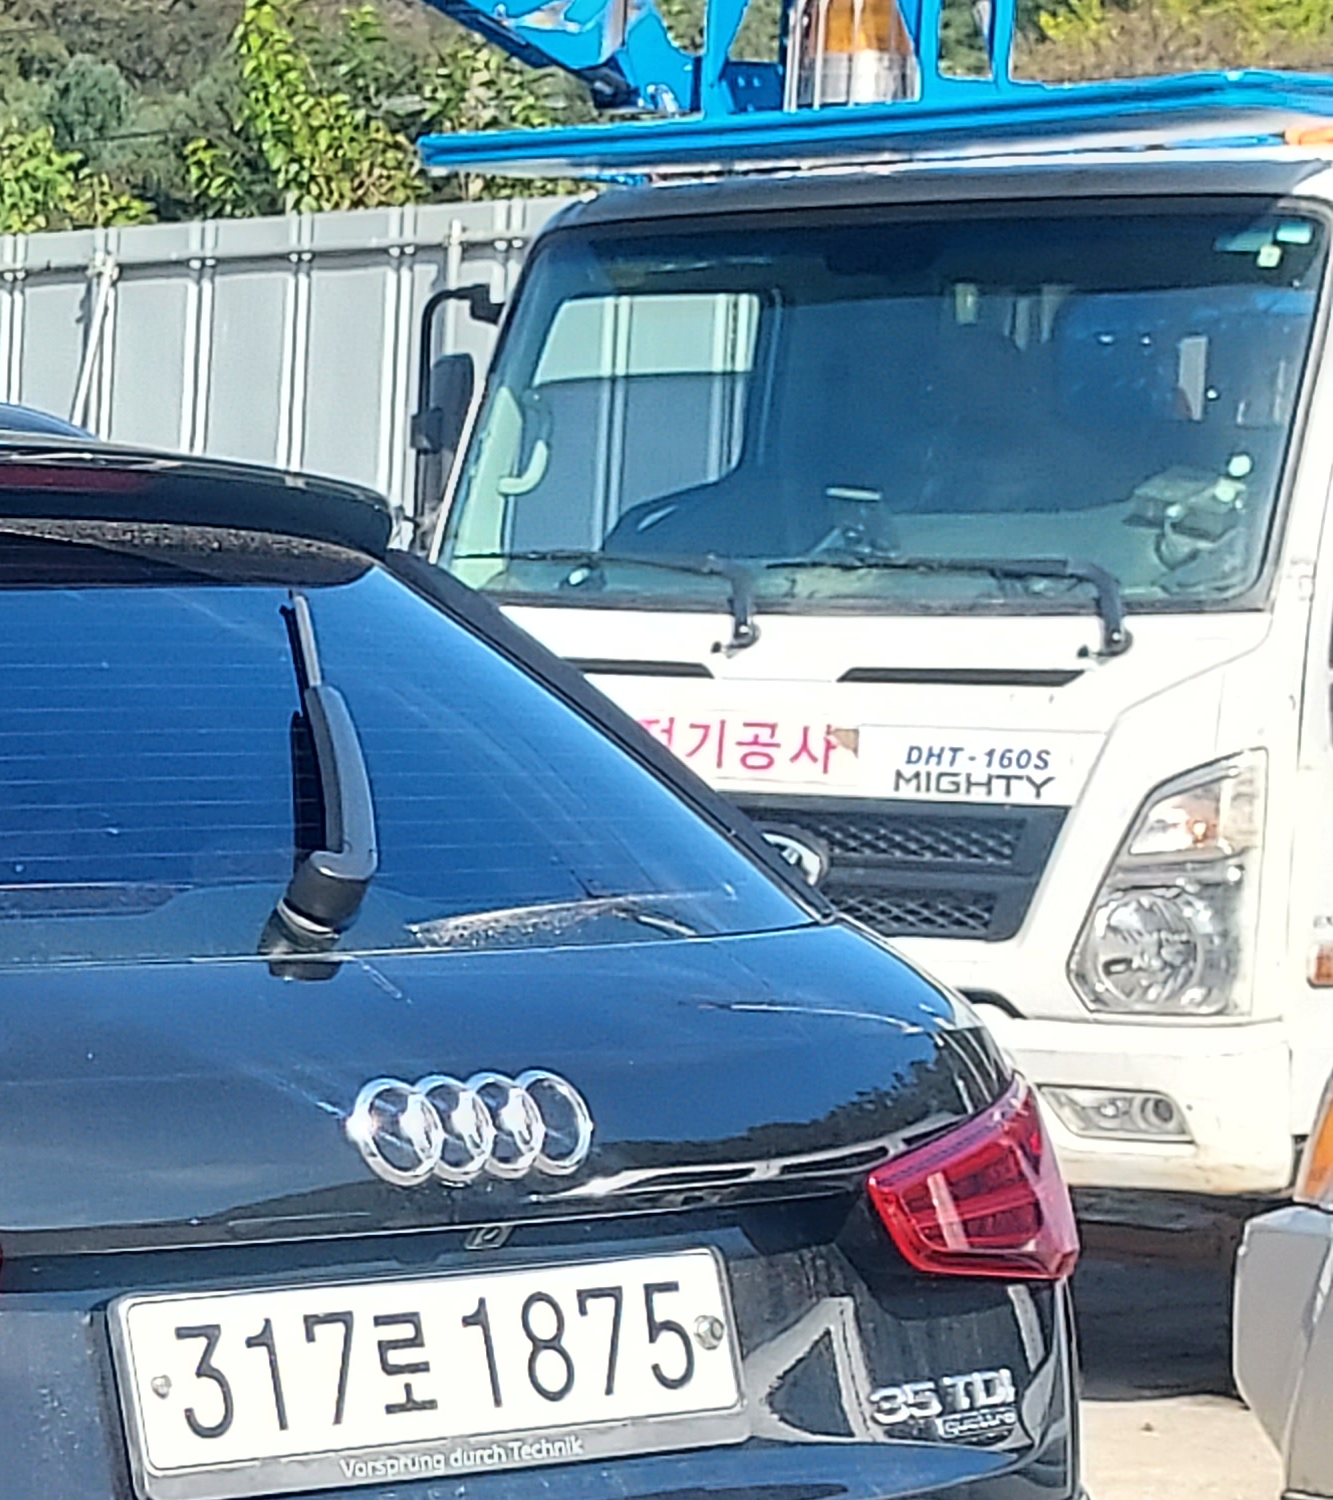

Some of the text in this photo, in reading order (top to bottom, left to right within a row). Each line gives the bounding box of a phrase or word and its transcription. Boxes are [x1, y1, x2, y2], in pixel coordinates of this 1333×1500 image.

[905, 745, 1052, 771] DHT-160S
[893, 768, 1056, 800] MIGHTY
[461, 1280, 696, 1409] 1875
[869, 1368, 1017, 1425] 35 TDI
[339, 1435, 584, 1478] Vorsprung durch Technik
